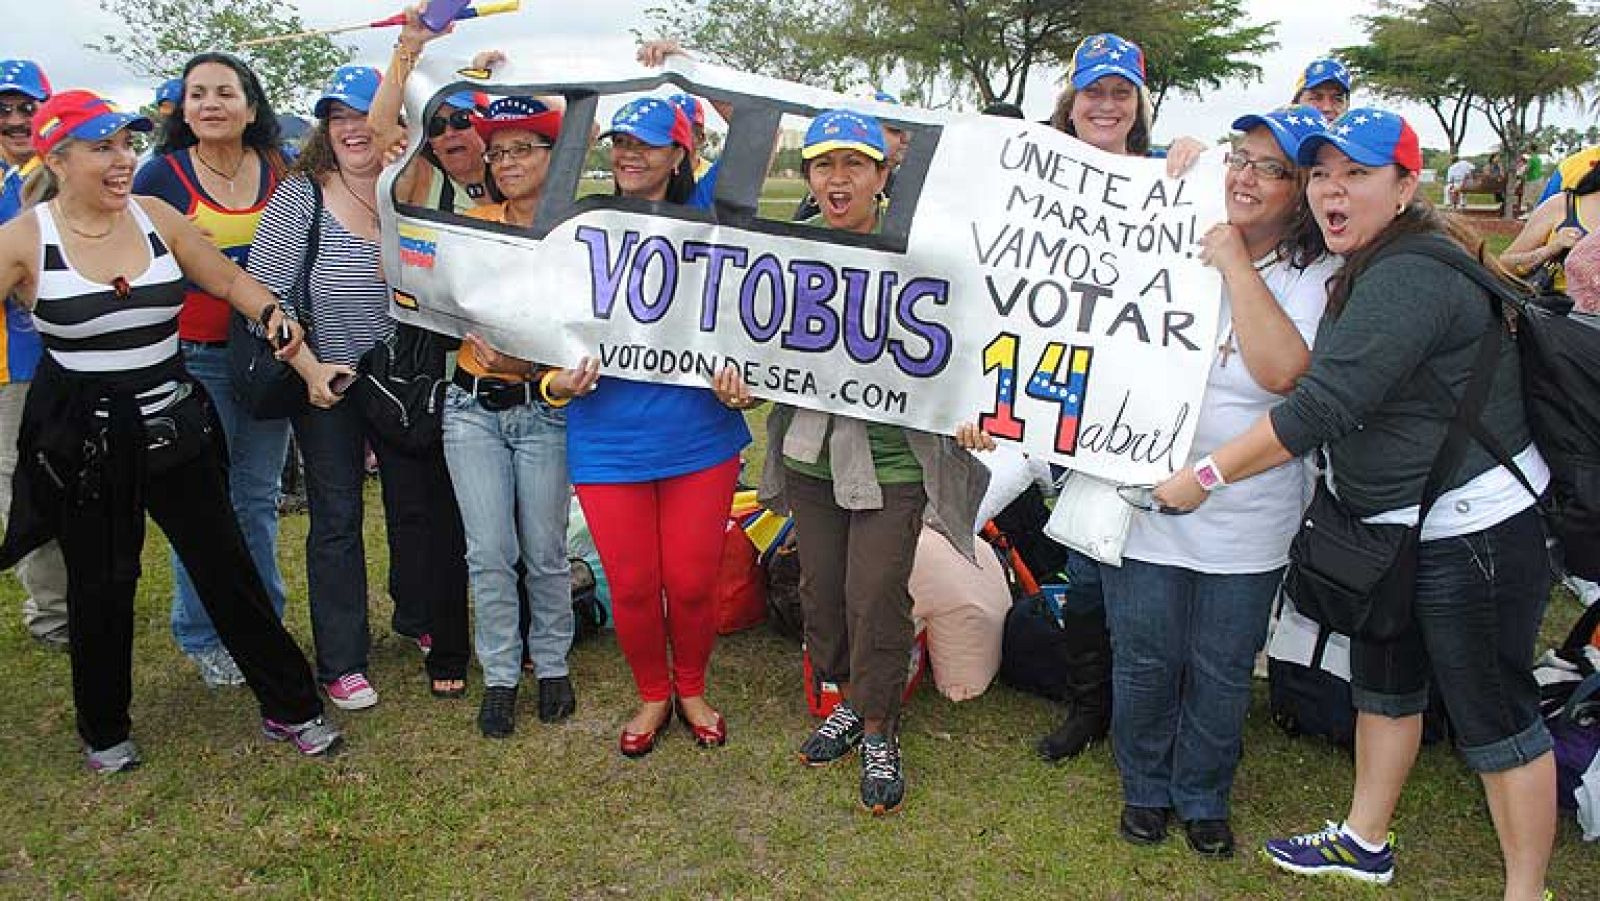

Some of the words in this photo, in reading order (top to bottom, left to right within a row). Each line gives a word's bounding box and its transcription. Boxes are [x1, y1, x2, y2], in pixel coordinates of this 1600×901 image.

[1001, 131, 1131, 210] ÚNETE
[1141, 179, 1195, 210] AL
[1006, 185, 1197, 258] MARATÓN!
[575, 225, 953, 377] VOTOBUS
[971, 222, 1119, 286] VAMOS
[1139, 268, 1172, 303] A
[985, 275, 1201, 351] VOTAR
[978, 331, 1094, 456] 14
[1078, 390, 1189, 473] abril
